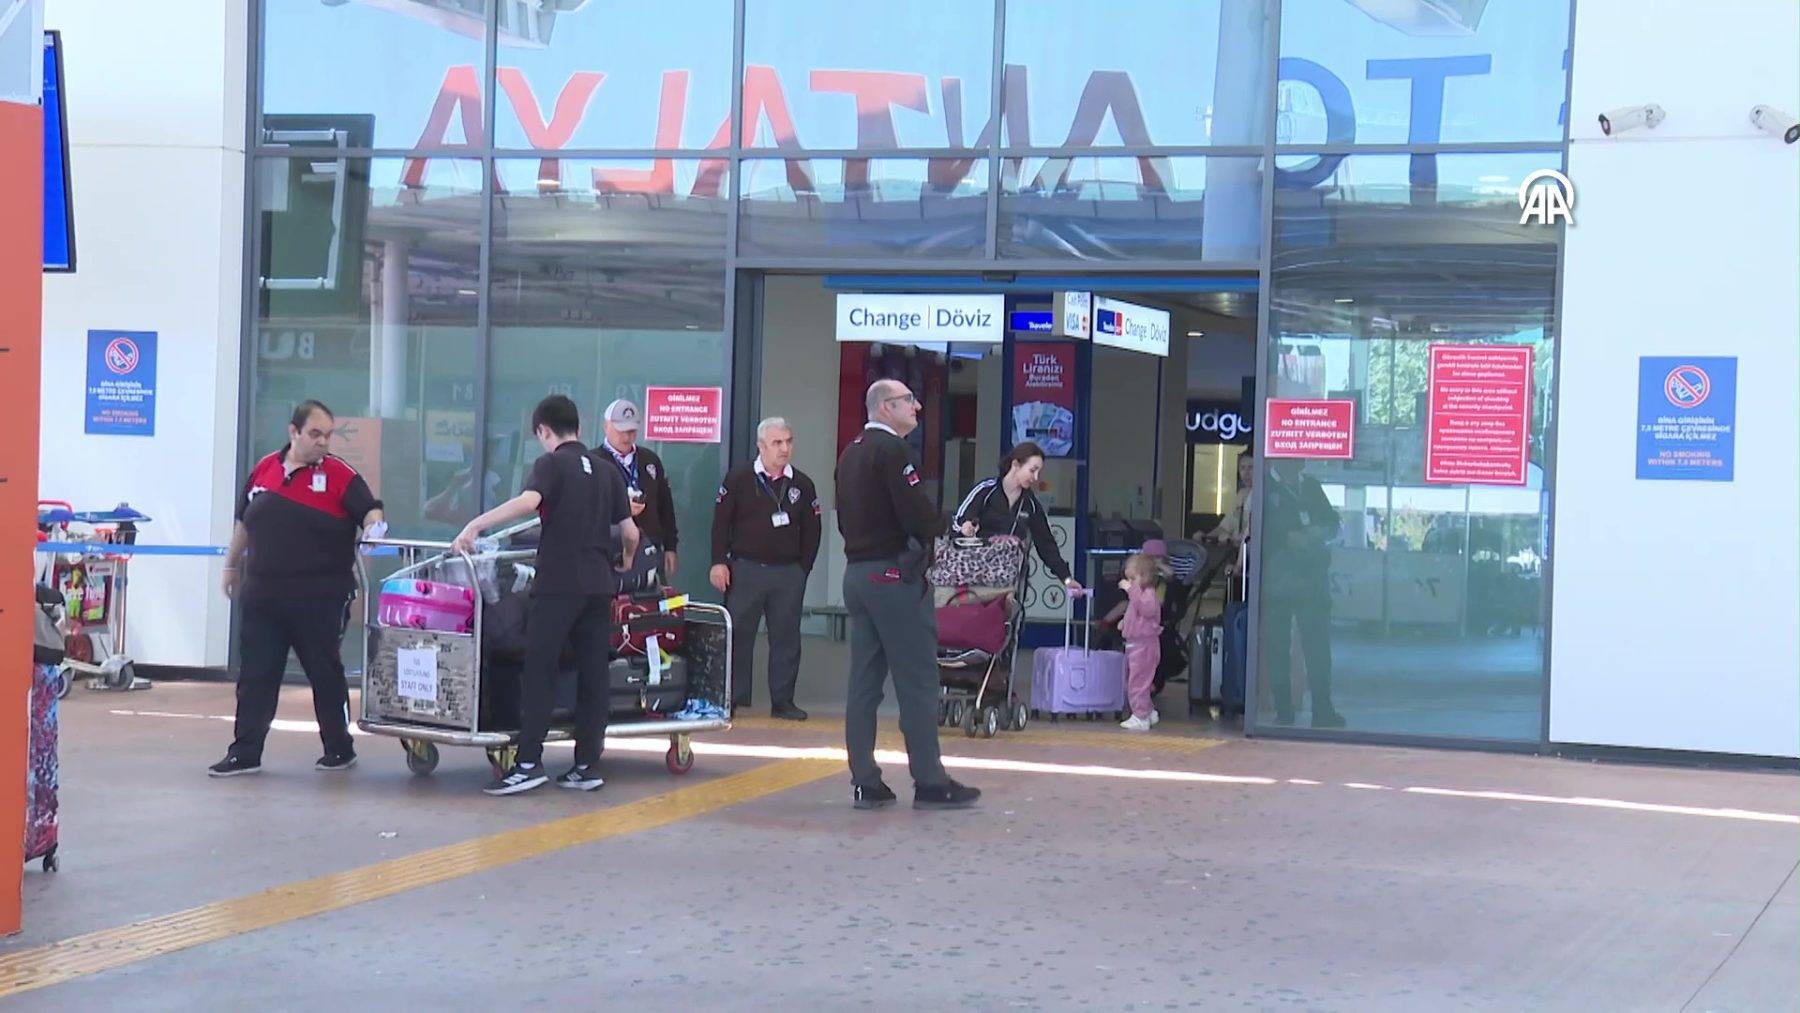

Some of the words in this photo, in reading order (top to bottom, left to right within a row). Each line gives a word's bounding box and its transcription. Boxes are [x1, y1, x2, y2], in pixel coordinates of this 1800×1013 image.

[849, 308, 922, 330] Change
[936, 307, 992, 328] Döviz
[1066, 312, 1080, 330] VISA
[1125, 318, 1148, 341] Change
[1150, 323, 1167, 342] Döviz
[1033, 354, 1057, 364] Türk
[1295, 420, 1337, 428] ENTRANCE
[1657, 416, 1676, 424] BİNA
[1305, 431, 1348, 439] VERBOTEN
[1690, 459, 1723, 467] METERS
